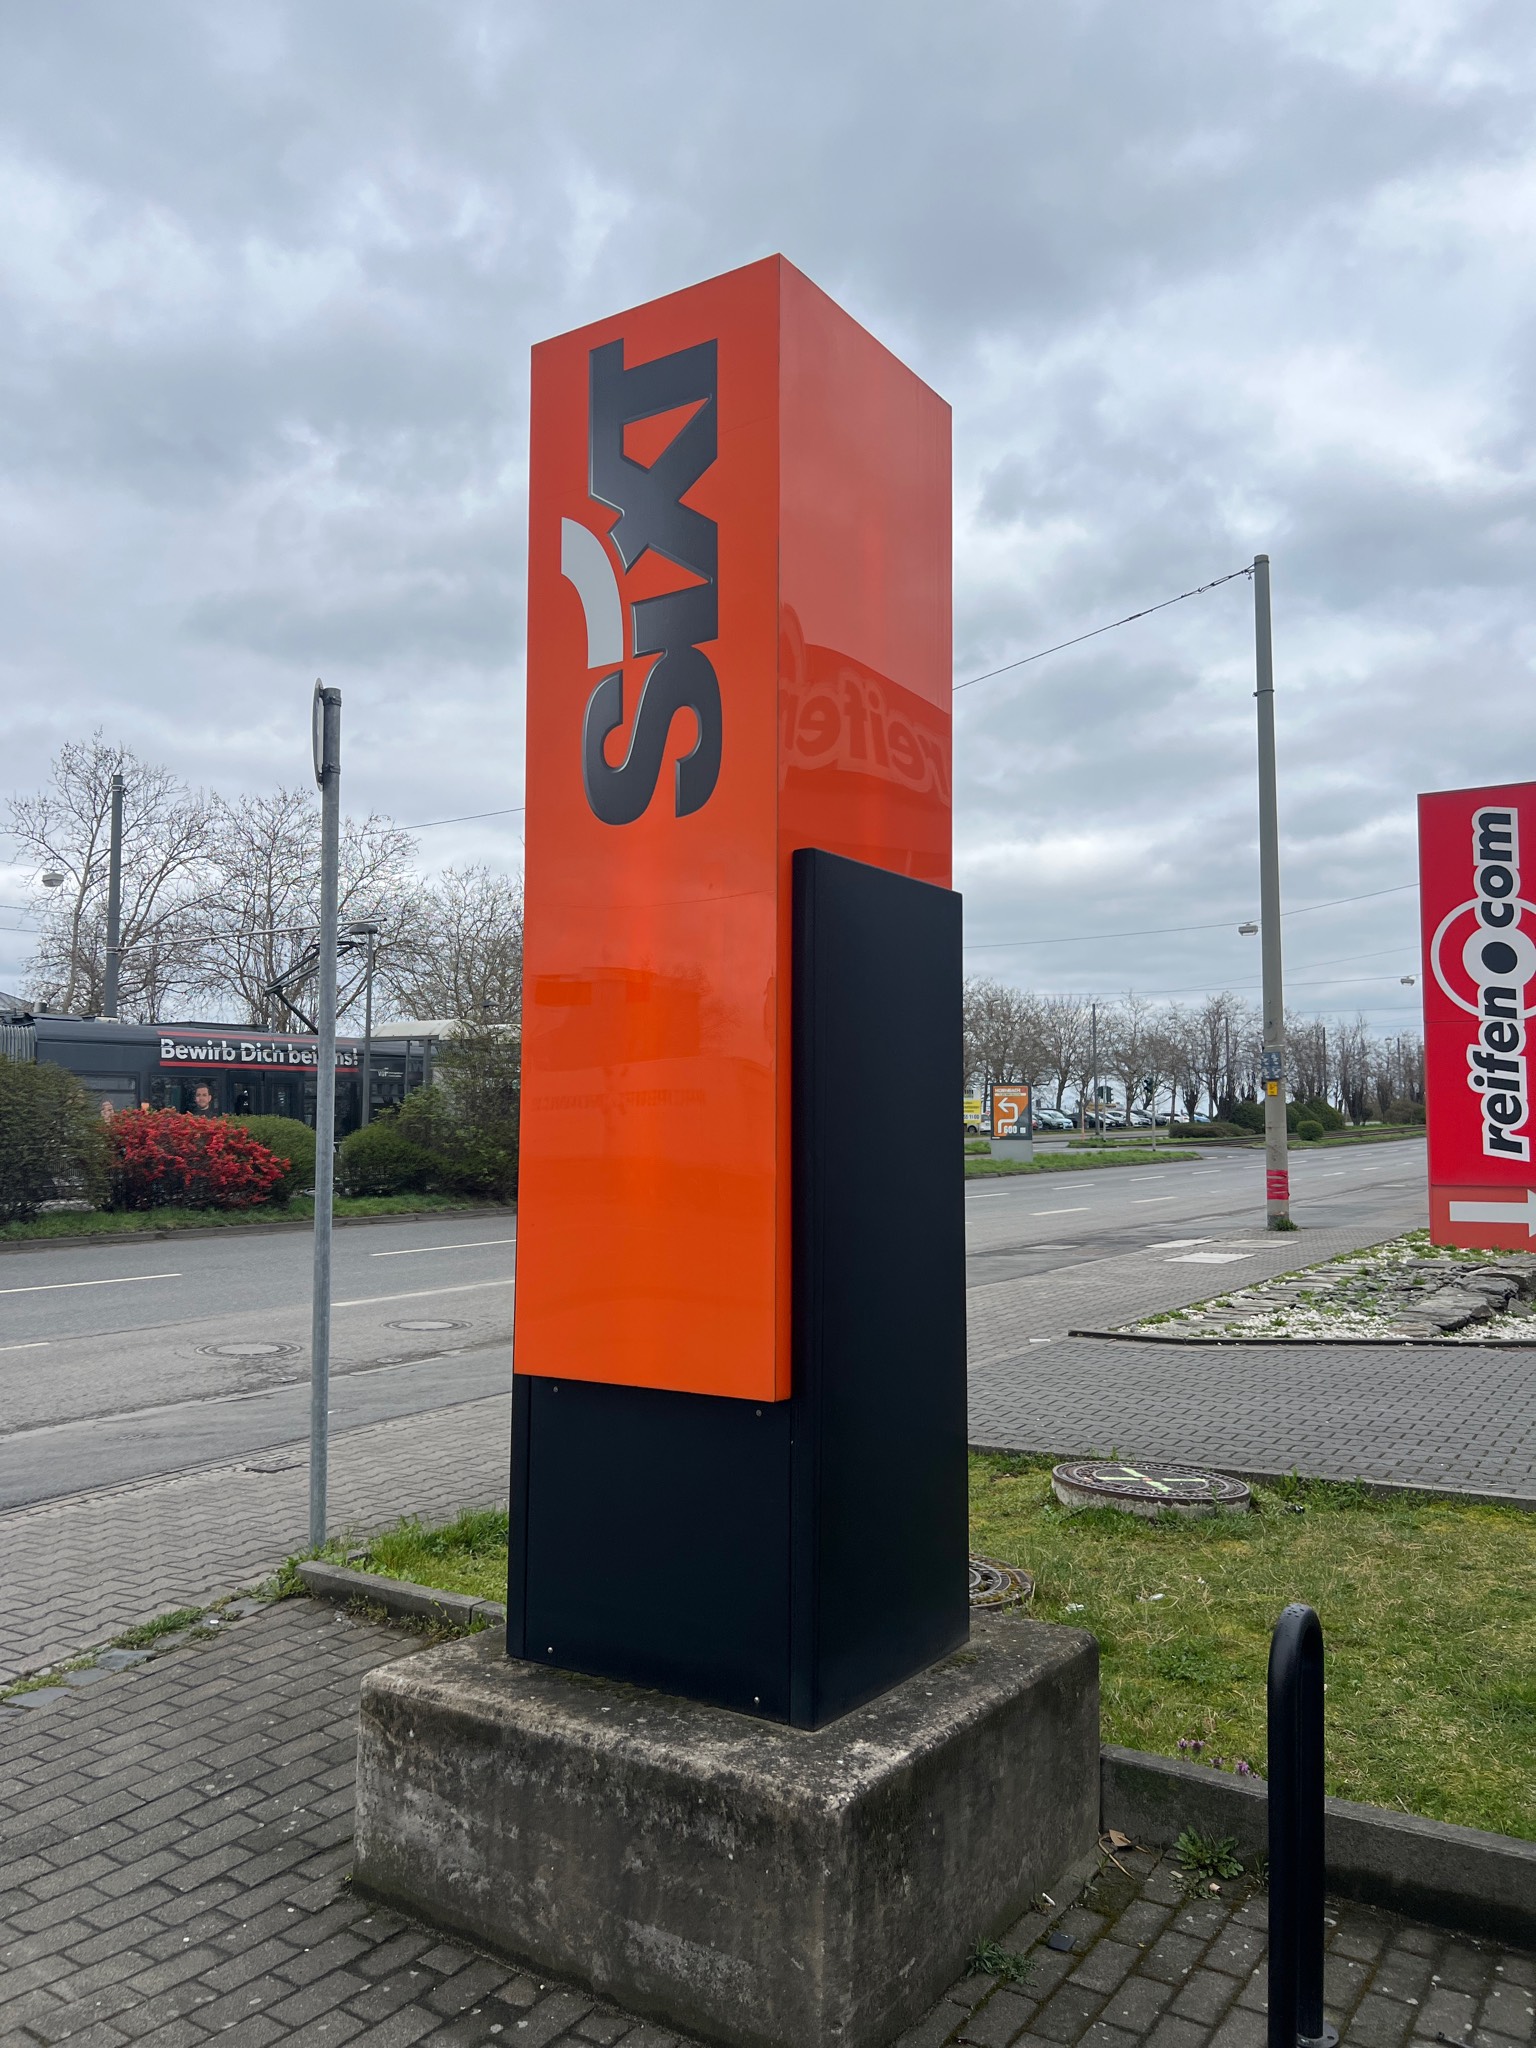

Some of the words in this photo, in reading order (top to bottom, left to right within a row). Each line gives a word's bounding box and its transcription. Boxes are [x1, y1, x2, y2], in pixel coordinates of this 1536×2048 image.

[160, 1038, 236, 1062] Bewirb
[241, 1042, 285, 1063] Dich
[288, 1043, 318, 1064] bei
[333, 1048, 358, 1066] ns!
